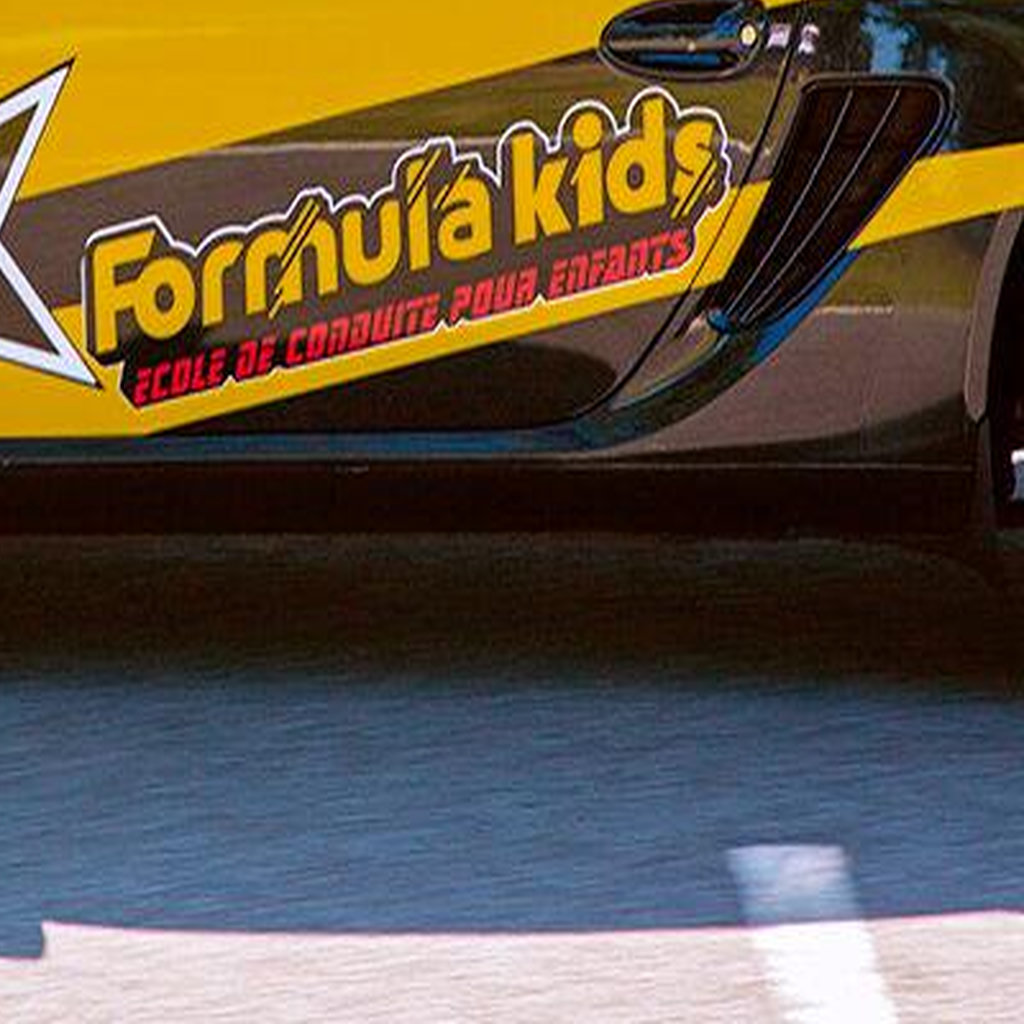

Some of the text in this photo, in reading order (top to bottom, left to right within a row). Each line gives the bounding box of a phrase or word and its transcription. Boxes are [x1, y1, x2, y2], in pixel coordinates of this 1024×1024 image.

[93, 94, 717, 354] Formula kids
[132, 229, 691, 406] ECOLE DE CONDUITE POUR ENFANTS
